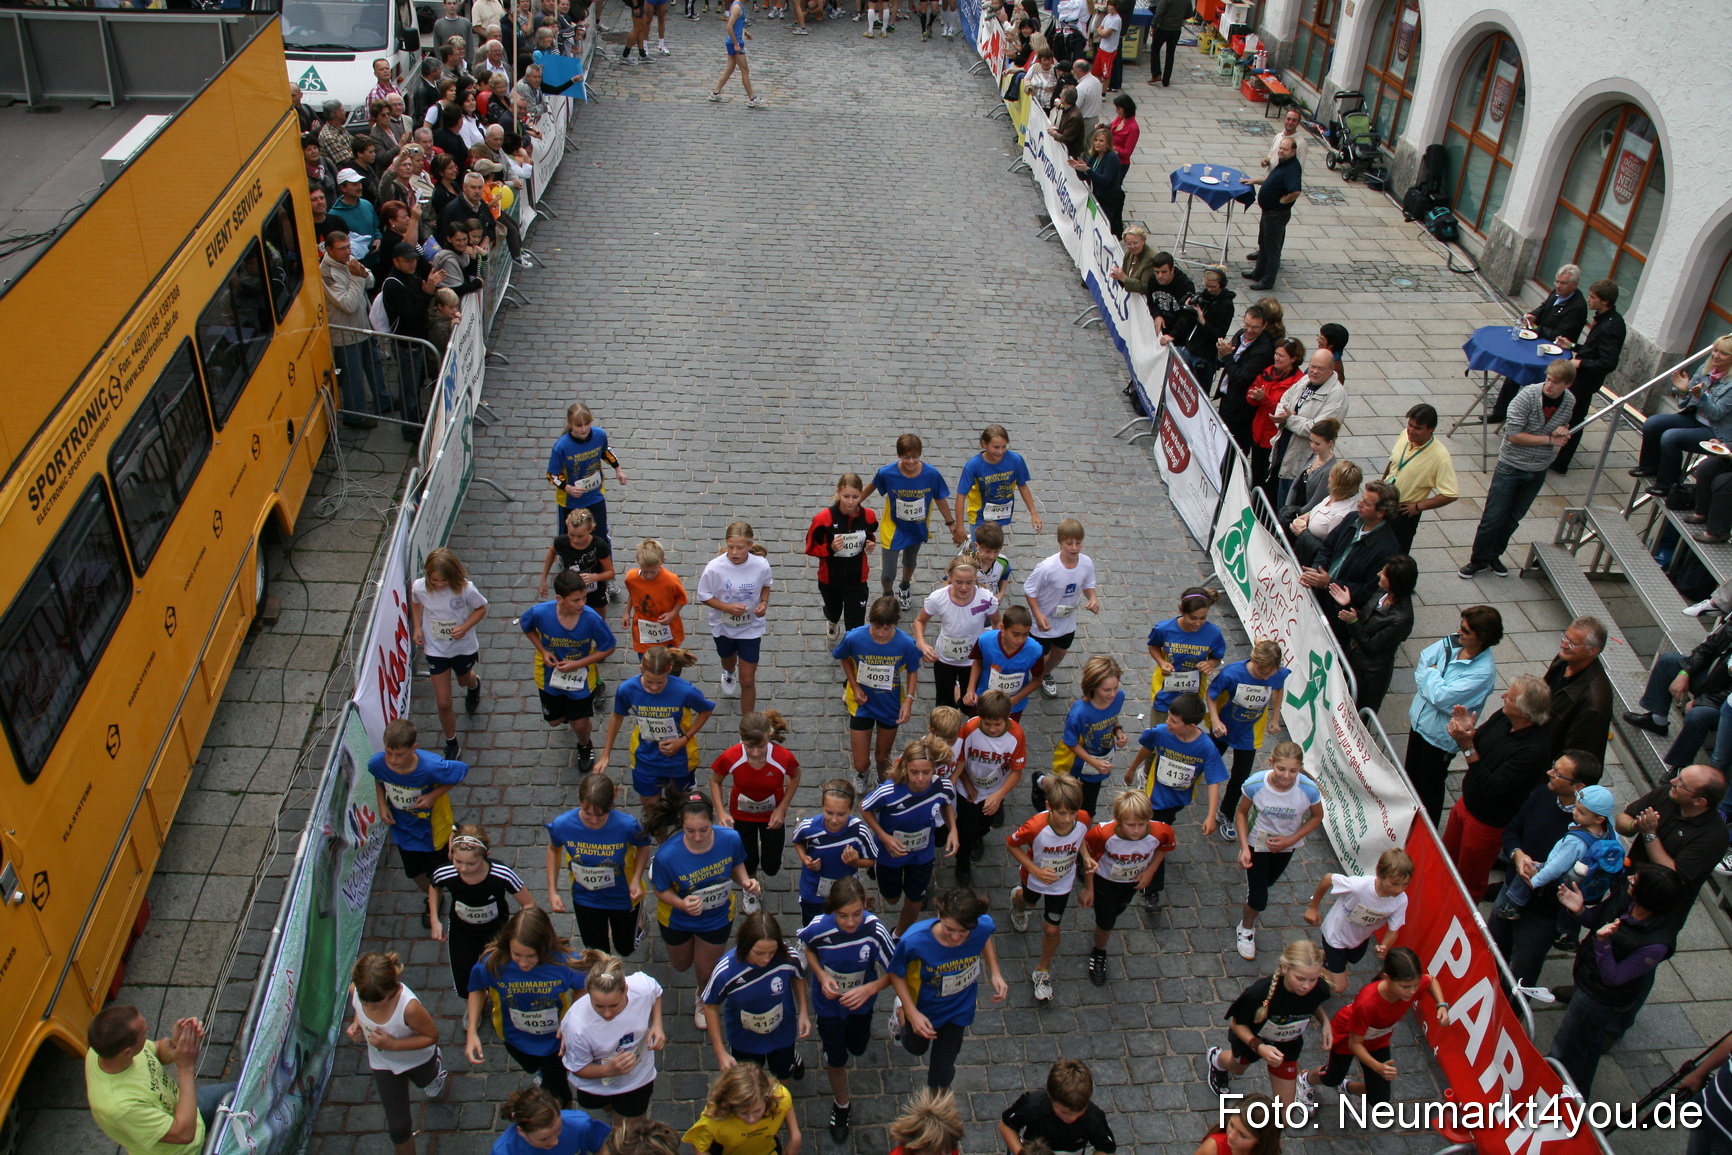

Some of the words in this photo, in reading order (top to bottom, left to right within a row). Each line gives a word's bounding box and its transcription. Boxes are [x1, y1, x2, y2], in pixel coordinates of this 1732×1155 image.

[1617, 173, 1636, 191] NEU
[1615, 185, 1632, 199] MARKT
[205, 221, 233, 268] EVENT
[232, 178, 264, 232] SERVICE
[123, 310, 180, 394] www.sportronic-gbr.de
[118, 355, 133, 377] Fon:
[1172, 361, 1181, 376] Wir
[1163, 416, 1172, 432] Wir
[27, 387, 109, 512] SPORTRONIC
[36, 474, 69, 526] ELECTRONIC
[67, 446, 88, 480] SPORTS
[85, 411, 112, 449] EQUIPMENT
[903, 507, 923, 516] 4128
[1281, 568, 1304, 613] UNS
[730, 614, 751, 622] 4011
[648, 628, 669, 637] 4012
[1169, 648, 1201, 656] STADTLAUF
[1171, 642, 1210, 653] NEUMARKTER
[561, 673, 584, 683] 4144
[866, 673, 890, 682] 4093
[998, 681, 1021, 690] 4053
[1174, 680, 1197, 689] 4147
[1244, 694, 1266, 703] 4004
[649, 726, 674, 734] 4083
[1166, 769, 1190, 781] 4132
[1331, 714, 1396, 842] www.jura-gebaeudeservice.de
[1320, 754, 1361, 856] Hausmeisterdienst
[566, 840, 577, 848] 10.
[577, 842, 624, 851] NEUMARKTER
[902, 836, 928, 847] 4125
[575, 847, 615, 856] STADTLAUF
[689, 856, 733, 879] NEUMARKTER
[583, 875, 611, 884] 4076
[689, 867, 726, 886] STADTLAUF
[703, 890, 729, 903] 4073
[936, 955, 980, 971] NEUMARKT
[954, 967, 978, 988] 4107
[508, 980, 562, 989] NEUMARKTER
[507, 987, 552, 995] STADTLAUF
[524, 1019, 555, 1028] 4032
[754, 1013, 780, 1028] 4123
[1274, 1028, 1302, 1037] 4094
